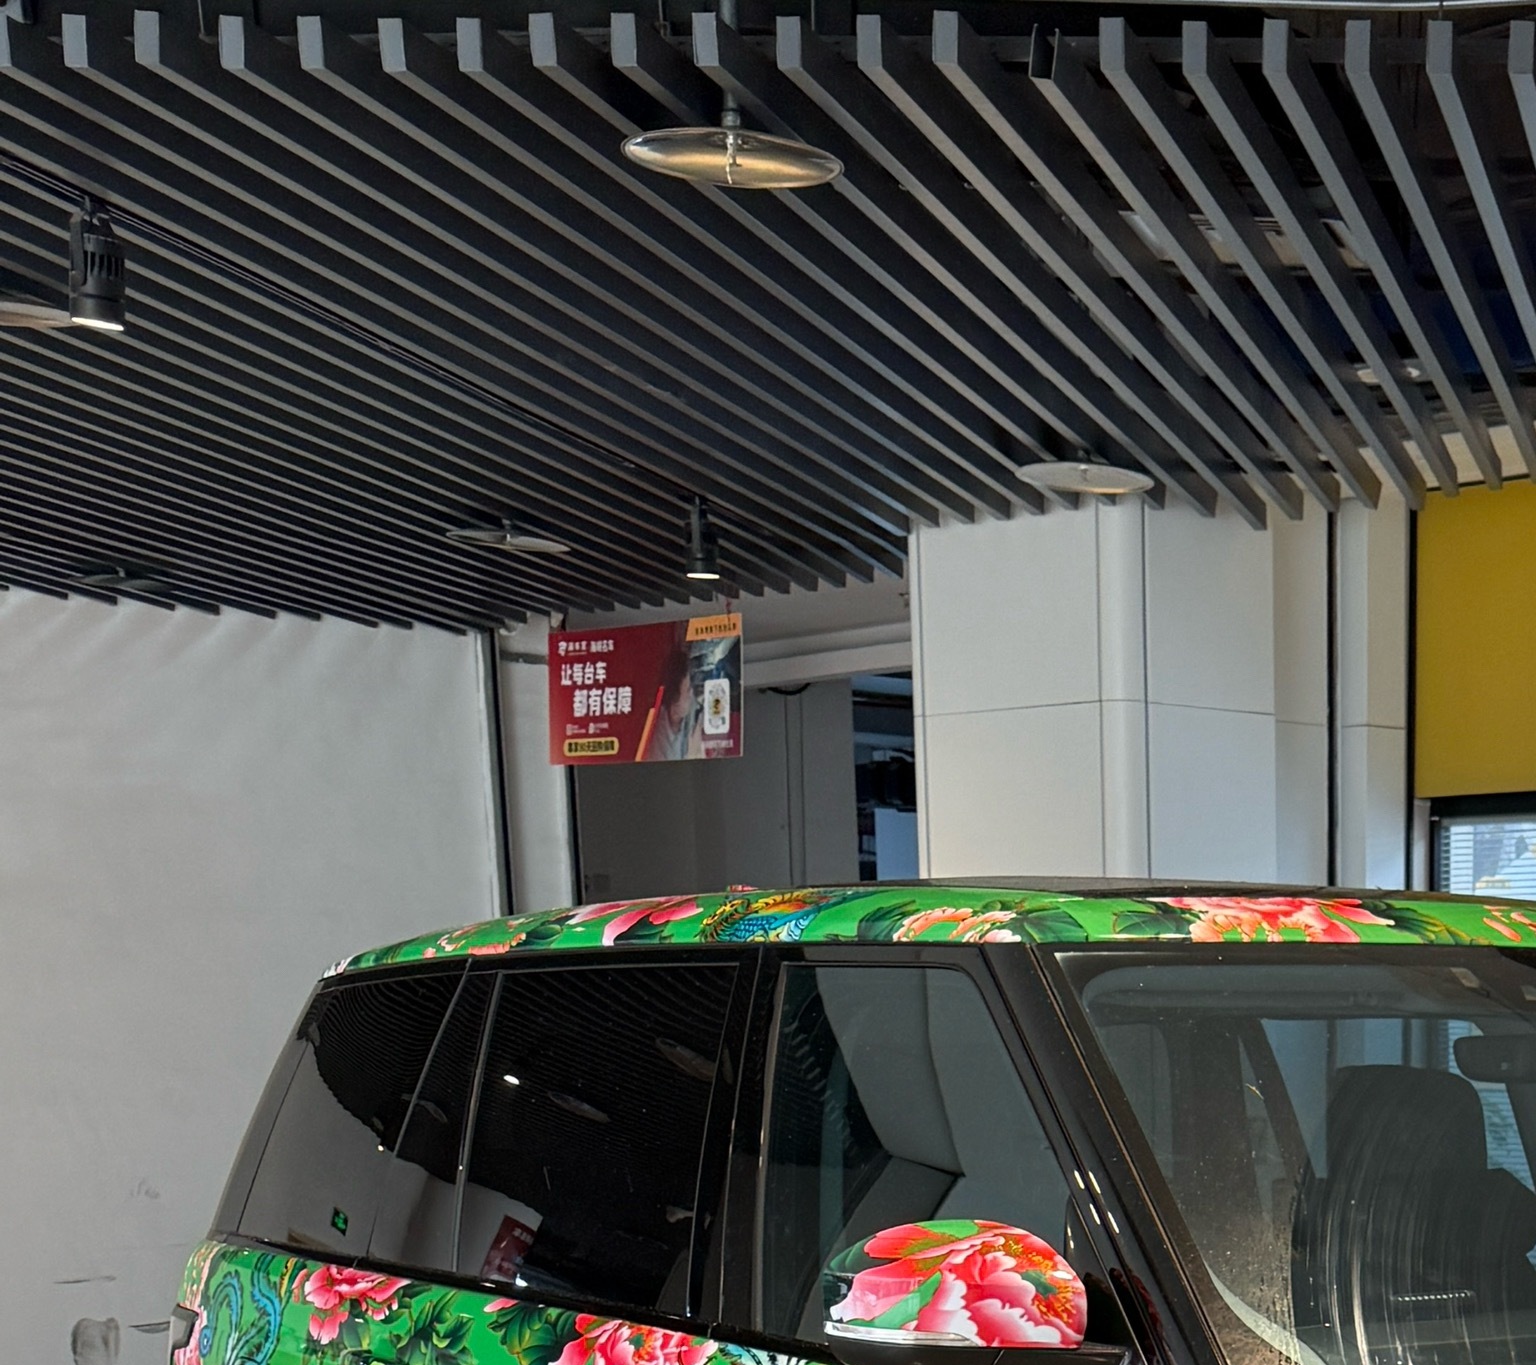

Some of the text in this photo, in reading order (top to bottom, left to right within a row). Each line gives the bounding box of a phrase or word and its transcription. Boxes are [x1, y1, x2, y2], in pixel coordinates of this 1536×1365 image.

[560, 661, 607, 686] 让每台车
[573, 686, 632, 718] 都有保障
